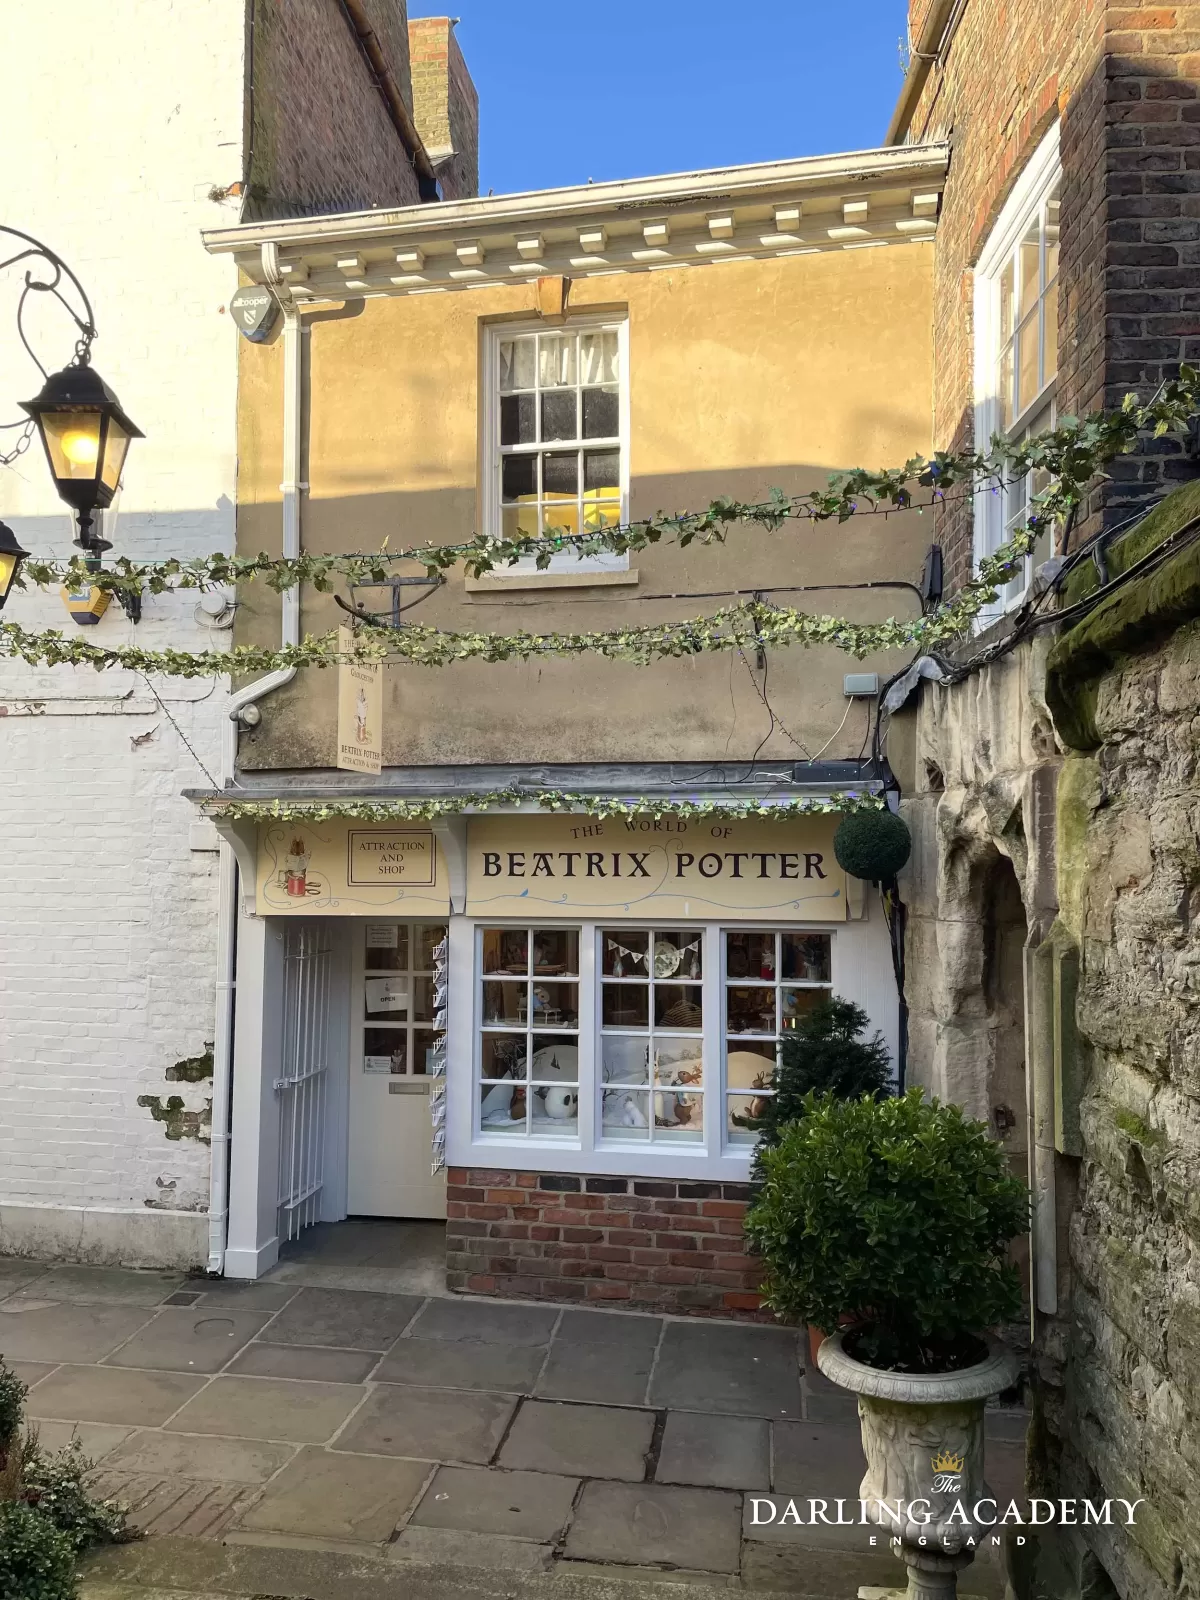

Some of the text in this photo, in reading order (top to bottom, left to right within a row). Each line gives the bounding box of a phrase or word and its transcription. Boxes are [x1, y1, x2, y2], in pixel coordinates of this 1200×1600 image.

[363, 749, 380, 760] POTTER
[570, 820, 733, 840] THE WORLD OF
[359, 842, 425, 851] ATTRACTION
[380, 853, 404, 863] AND
[378, 865, 405, 875] SHOP
[482, 852, 828, 880] BEATRIX POTTER
